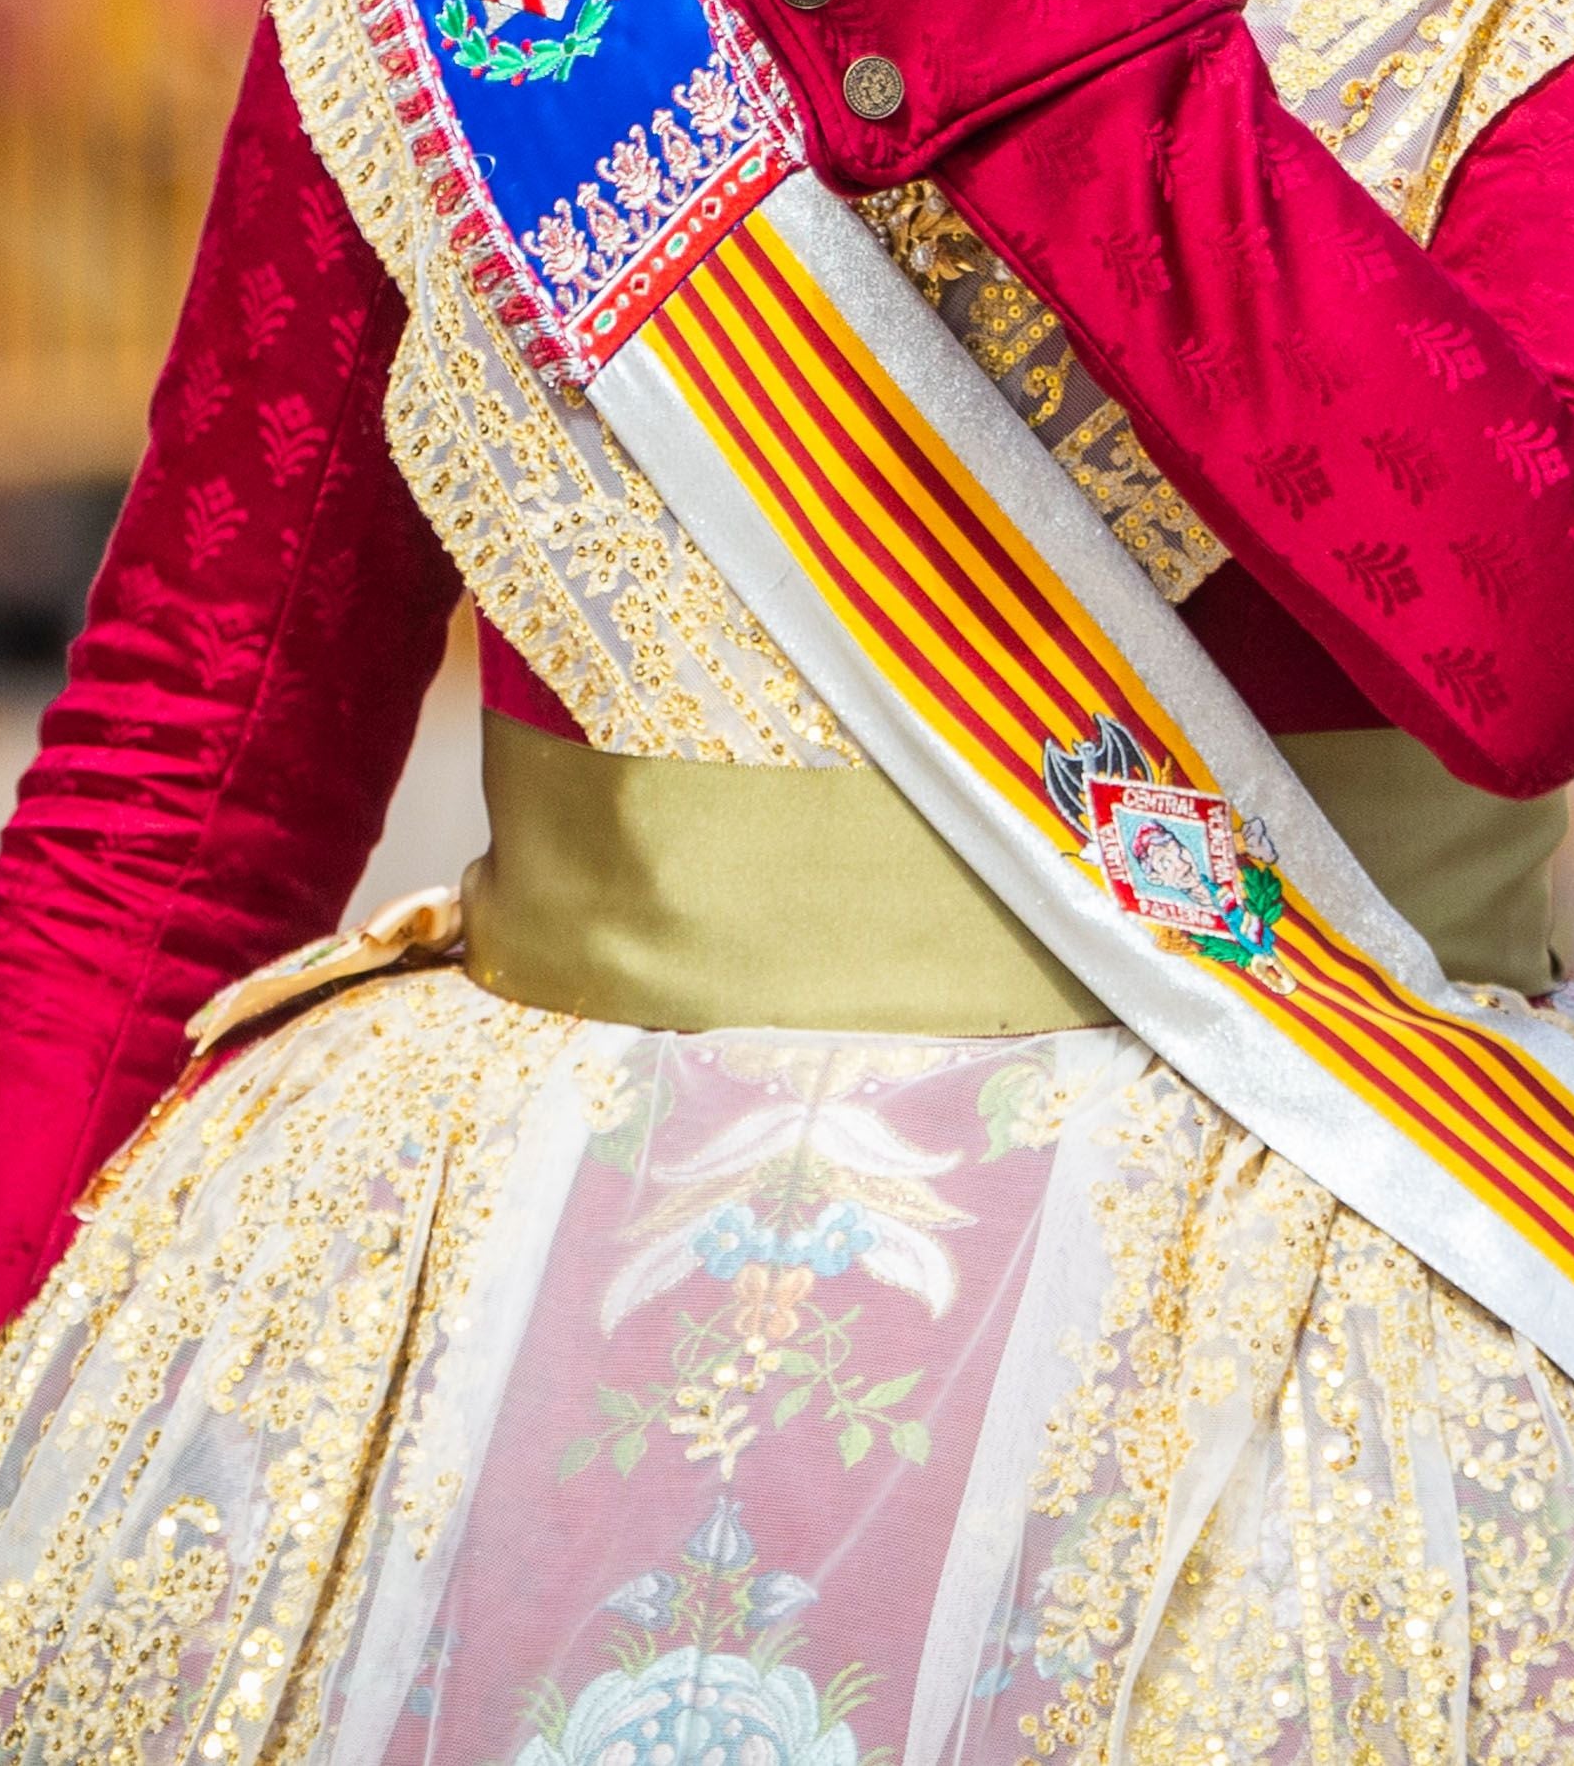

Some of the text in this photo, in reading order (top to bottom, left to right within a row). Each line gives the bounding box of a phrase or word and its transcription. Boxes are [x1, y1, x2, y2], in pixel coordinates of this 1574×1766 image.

[1122, 788, 1200, 818] CENTRAL
[1098, 823, 1130, 884] JUNTA
[1207, 805, 1234, 884] VALENCIA
